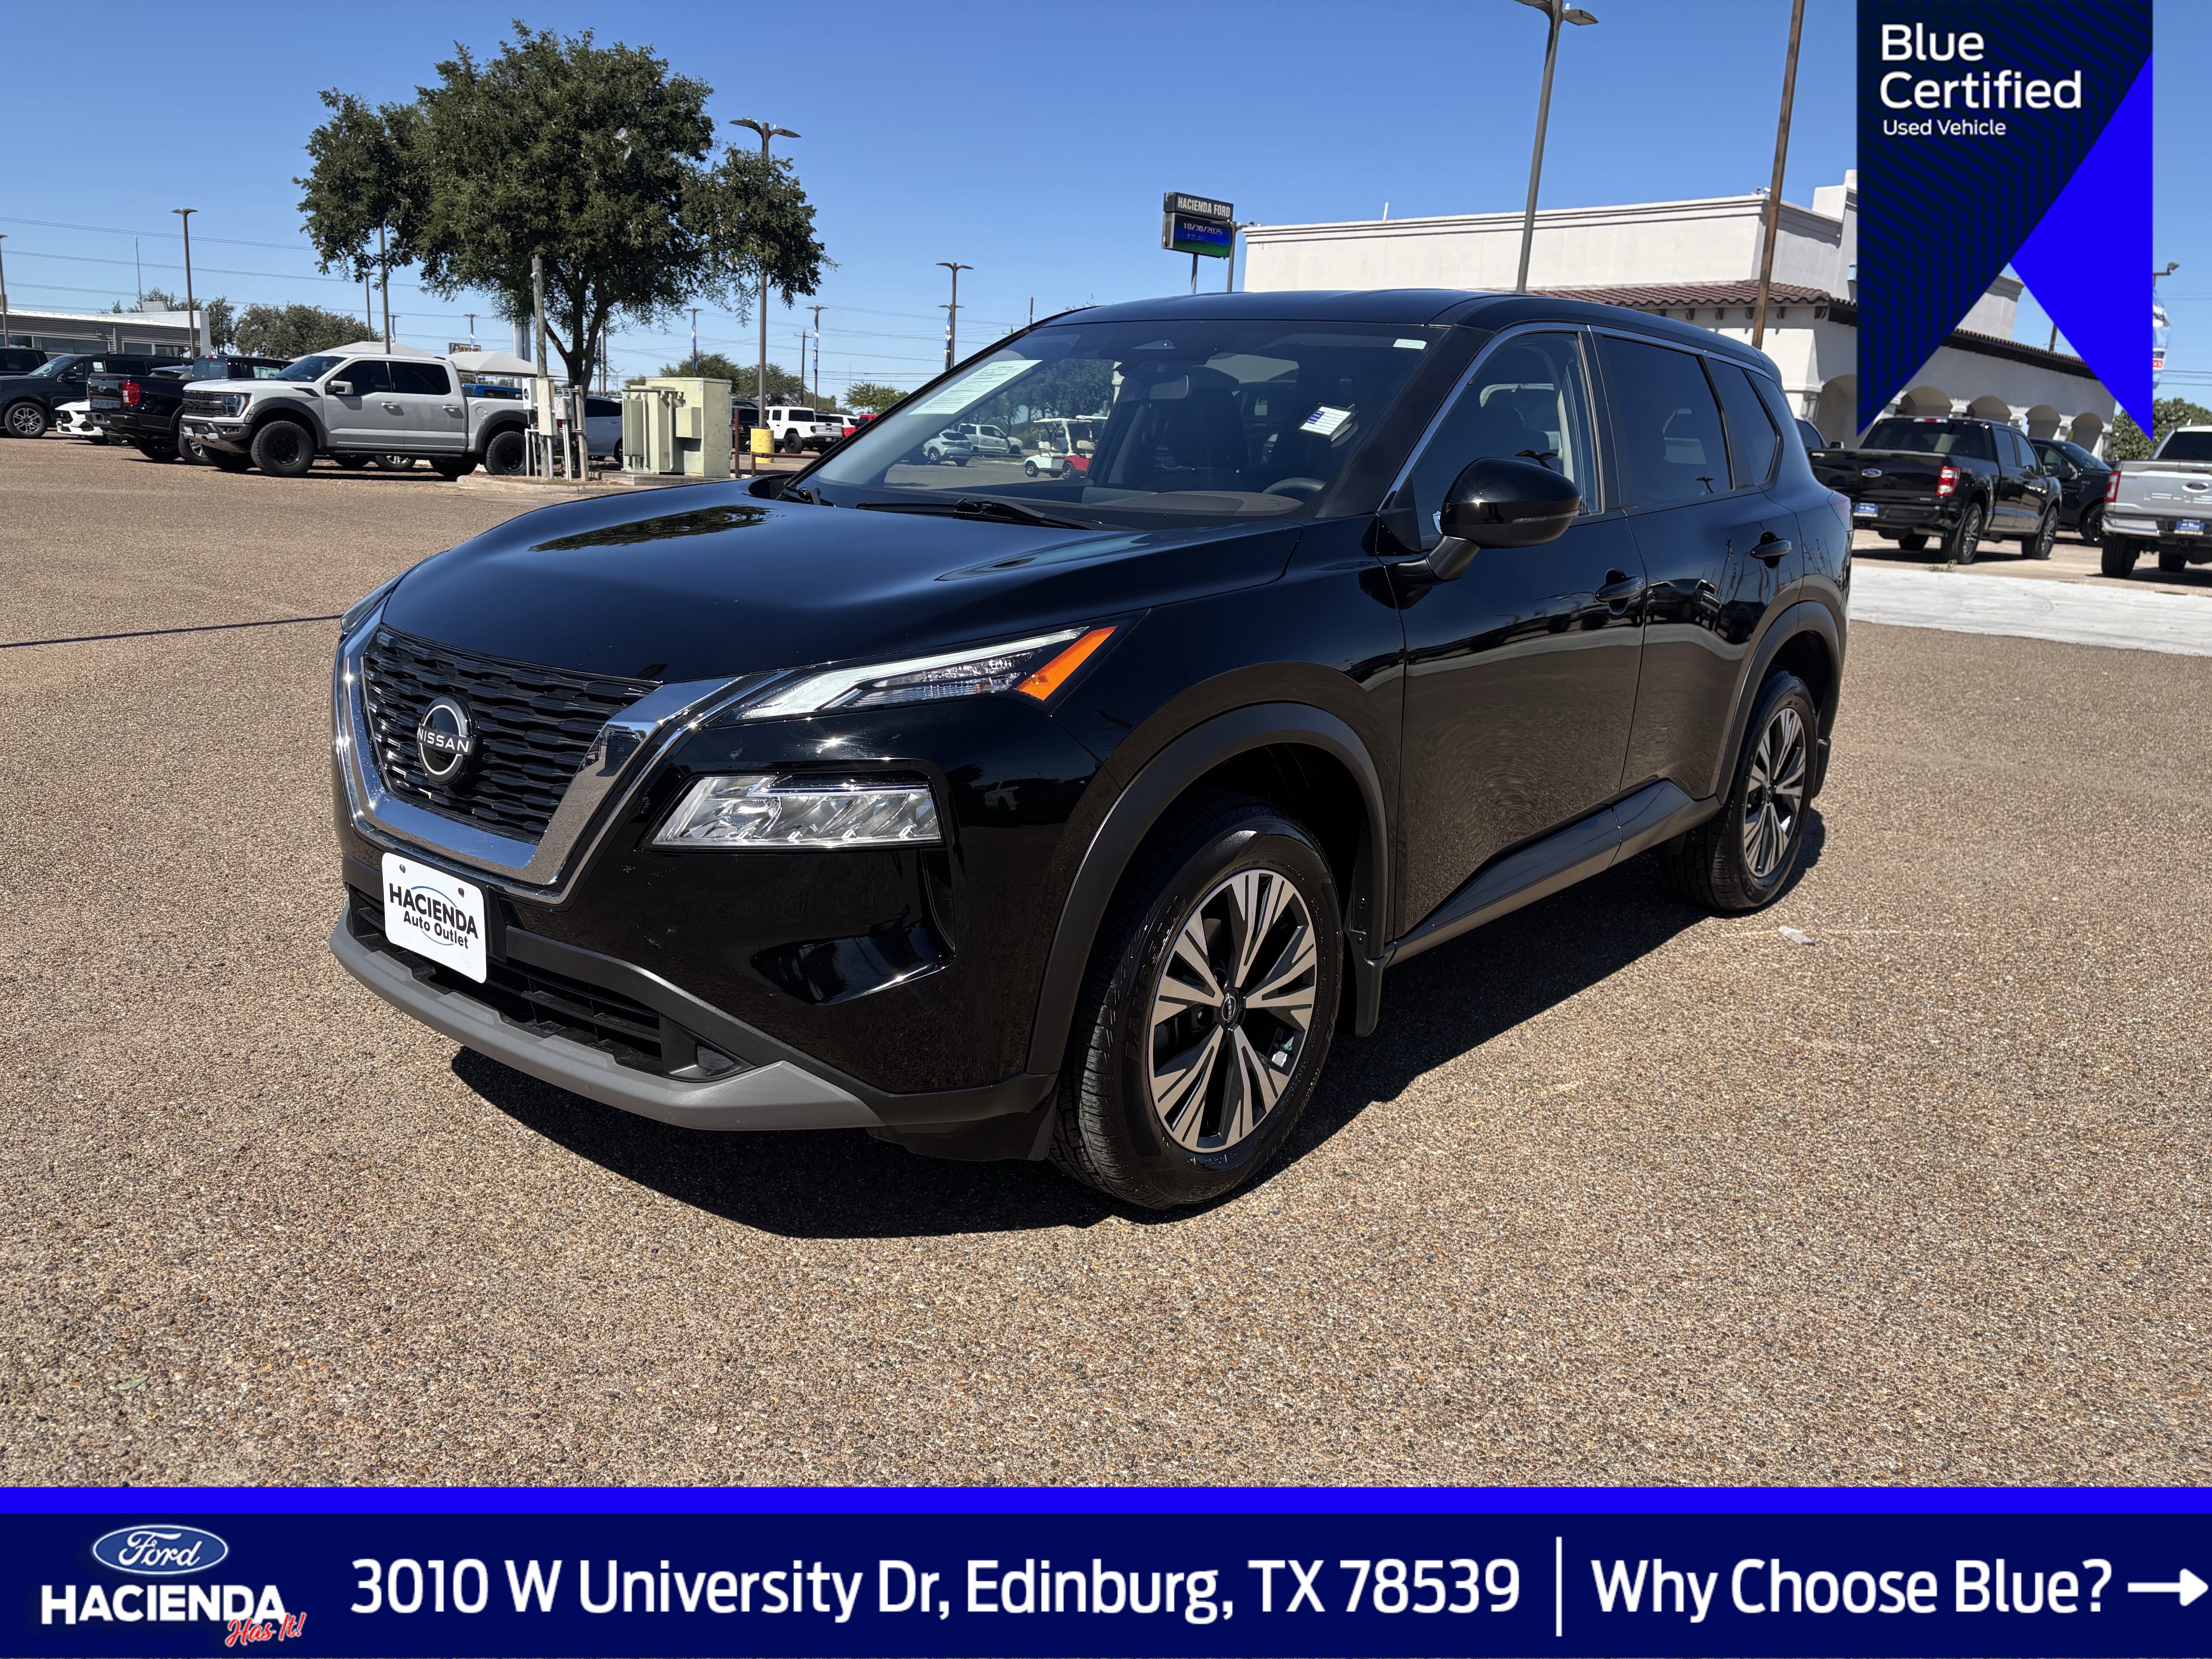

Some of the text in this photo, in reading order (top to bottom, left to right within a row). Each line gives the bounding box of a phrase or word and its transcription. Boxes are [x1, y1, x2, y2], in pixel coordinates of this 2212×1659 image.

[1178, 197, 1231, 218] HACIENDA FORD
[1183, 223, 1223, 235] 10/30/2025
[418, 728, 469, 753] NISSAN
[389, 883, 479, 939] HACIENDA
[404, 910, 468, 950] Auto Outlet
